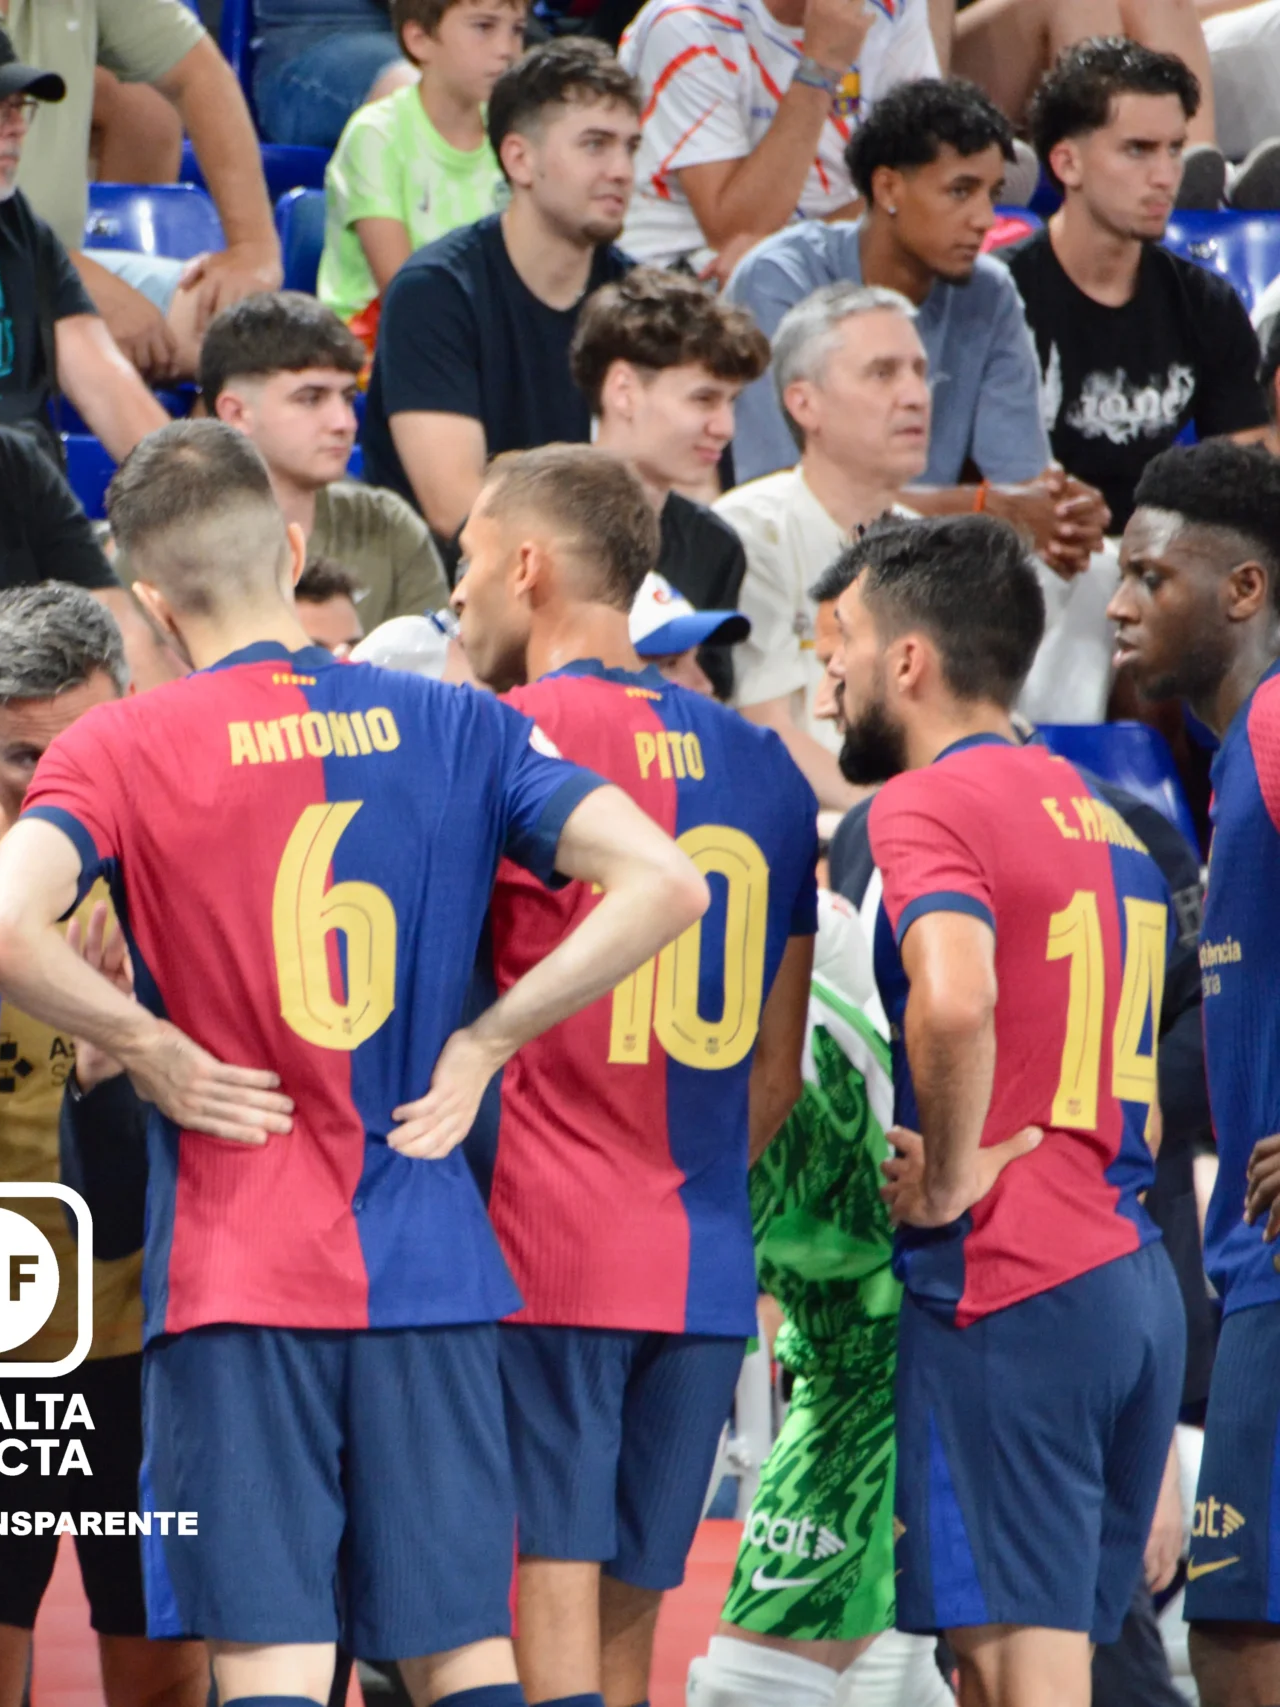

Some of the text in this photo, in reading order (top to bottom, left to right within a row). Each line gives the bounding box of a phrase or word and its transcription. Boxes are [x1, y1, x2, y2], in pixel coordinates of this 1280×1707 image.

[228, 706, 401, 766] ANTONIO
[634, 731, 705, 780] PITO
[272, 800, 397, 1051] 6
[1046, 889, 1168, 1144] 14
